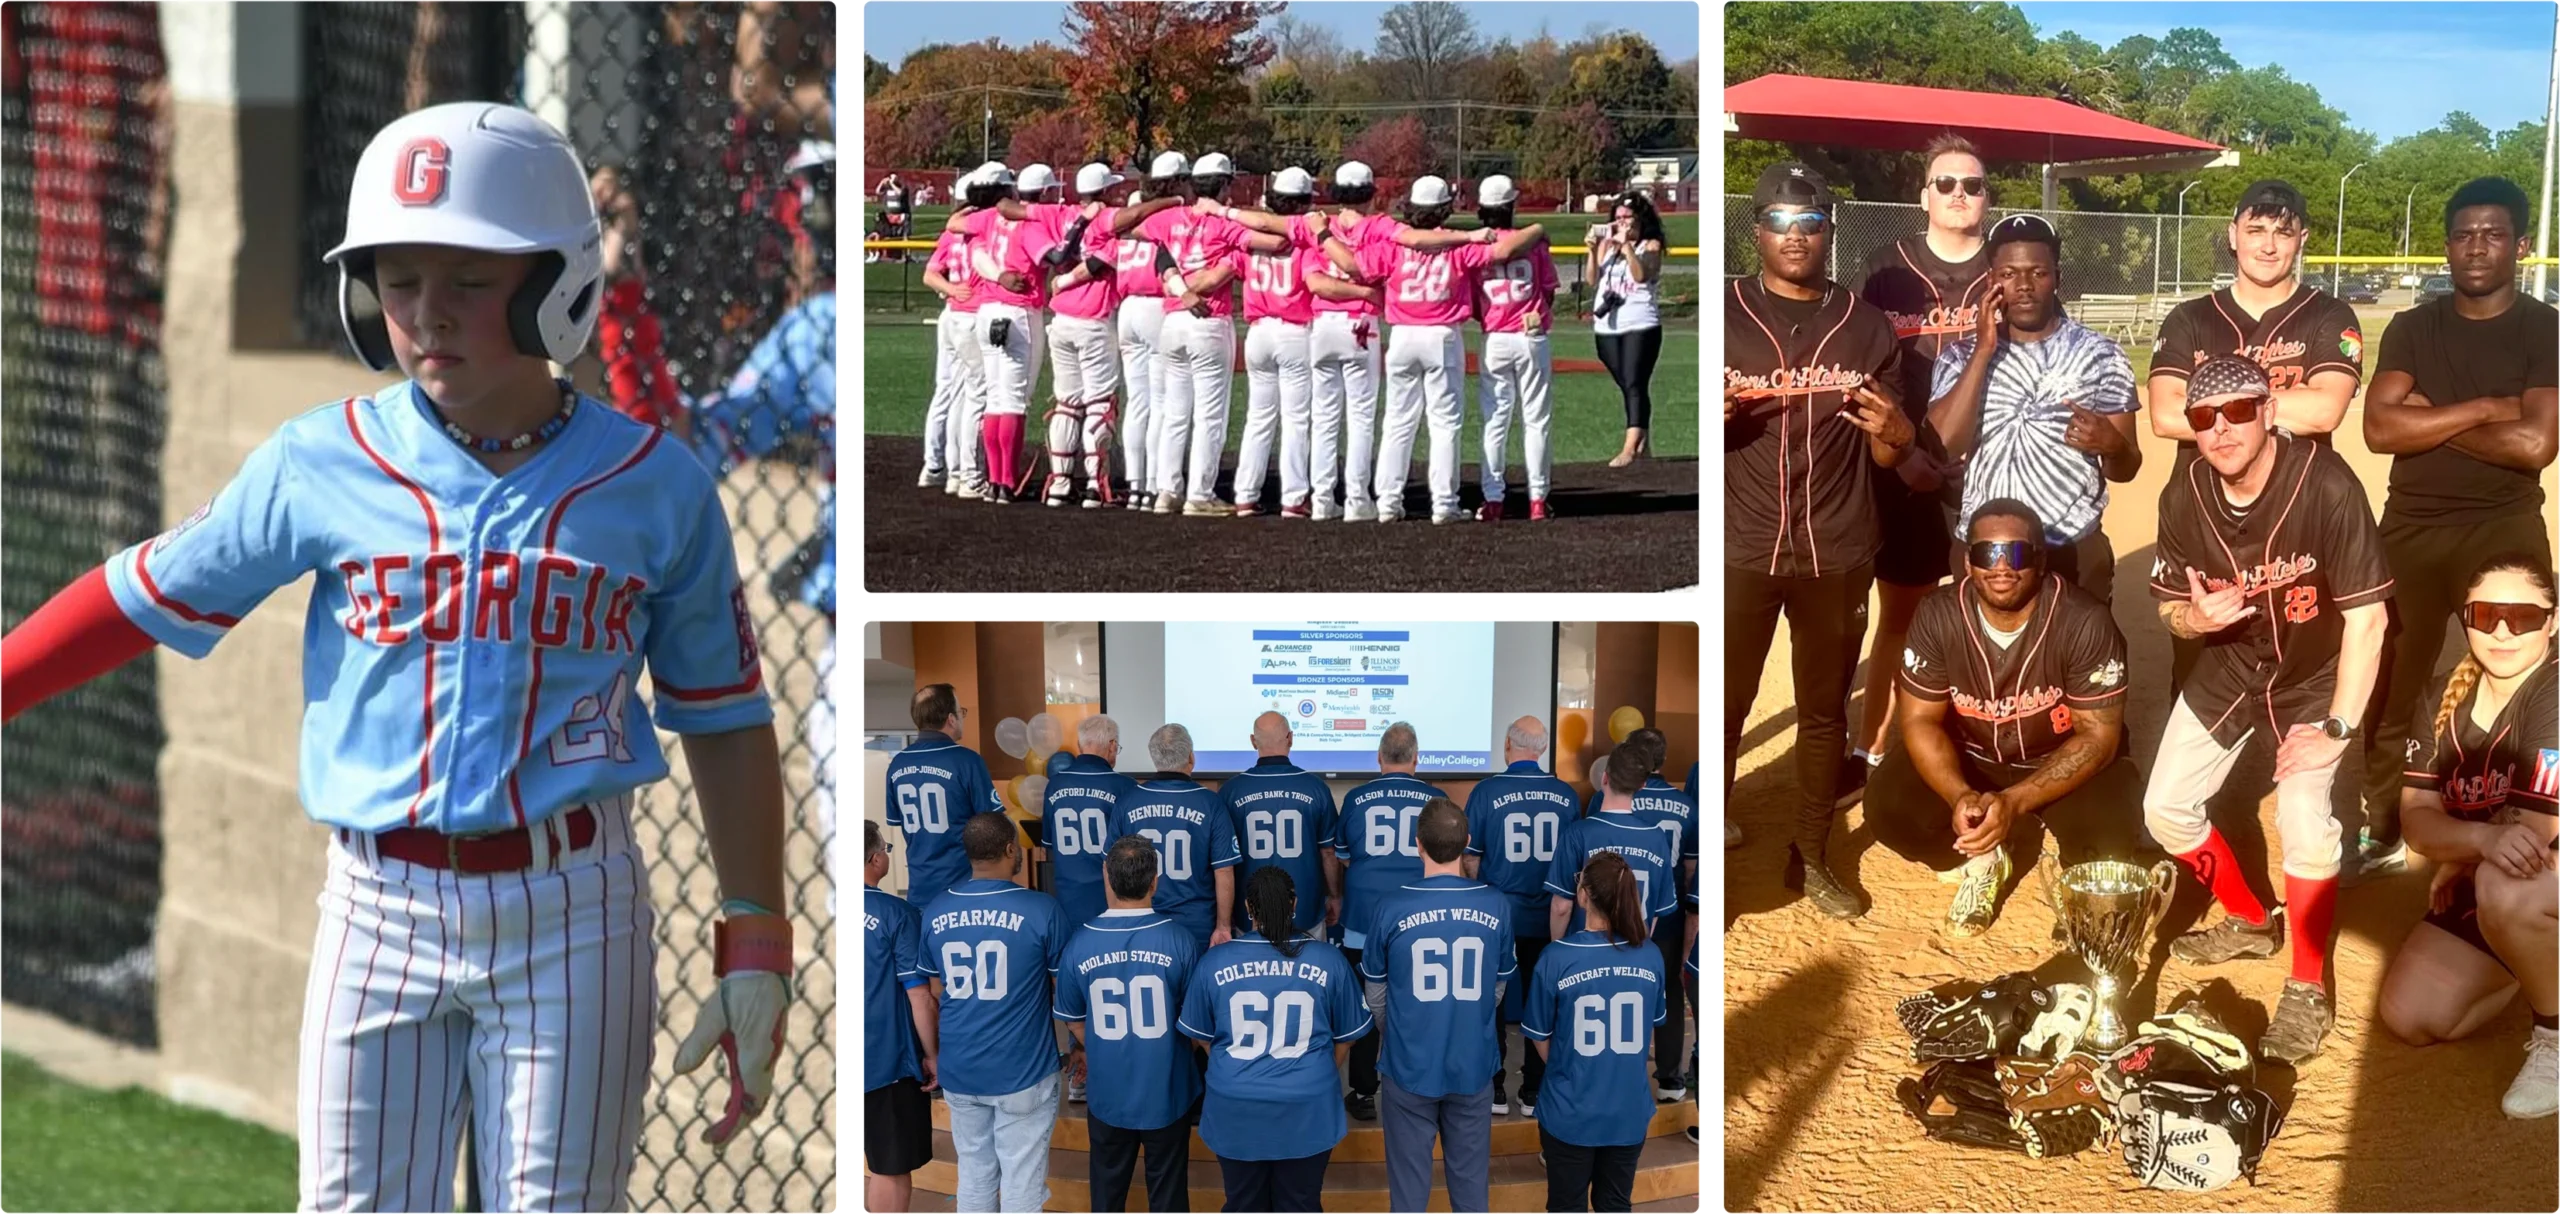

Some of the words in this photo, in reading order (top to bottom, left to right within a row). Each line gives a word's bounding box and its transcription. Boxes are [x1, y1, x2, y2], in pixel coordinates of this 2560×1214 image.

[389, 135, 451, 207] G
[2269, 366, 2304, 390] 27
[338, 550, 647, 655] GEORGIA
[1325, 632, 1363, 640] SPONSORS
[1264, 658, 1297, 668] ALPHA
[2050, 703, 2073, 735] 8
[897, 782, 949, 834] 60
[1086, 789, 1116, 804] LINEAR
[1235, 792, 1263, 808] ILLINOIS
[1264, 790, 1283, 798] BANK
[1291, 791, 1313, 804] TRUST
[1355, 790, 1384, 806] OLSON
[1493, 792, 1523, 809] ALPHA
[1525, 791, 1570, 807] CONTROLS
[1631, 797, 1690, 819] RUSADER
[1128, 805, 1173, 824] HENNIG
[1176, 805, 1205, 826] AME
[1054, 807, 1107, 855] 60
[1246, 809, 1302, 859] 60
[1504, 811, 1559, 863] 60
[1624, 846, 1648, 858] FIRST
[1647, 851, 1665, 868] RATE
[932, 909, 1024, 935] SPEARMAN
[1398, 909, 1446, 932] SAVANT
[1450, 908, 1500, 930] WEALTH
[941, 940, 1008, 1001] 60
[1078, 951, 1127, 975] MIDLAND
[1130, 950, 1173, 968] STATES
[1214, 960, 1295, 987] COLEMAN
[1298, 963, 1329, 988] CPA
[1411, 936, 1484, 1002] 60
[1557, 967, 1610, 991] BODYCRAFT
[1612, 966, 1656, 983] WELLNESS
[1089, 975, 1168, 1041] 60
[1226, 990, 1315, 1061] 60
[1573, 991, 1644, 1057] 60
